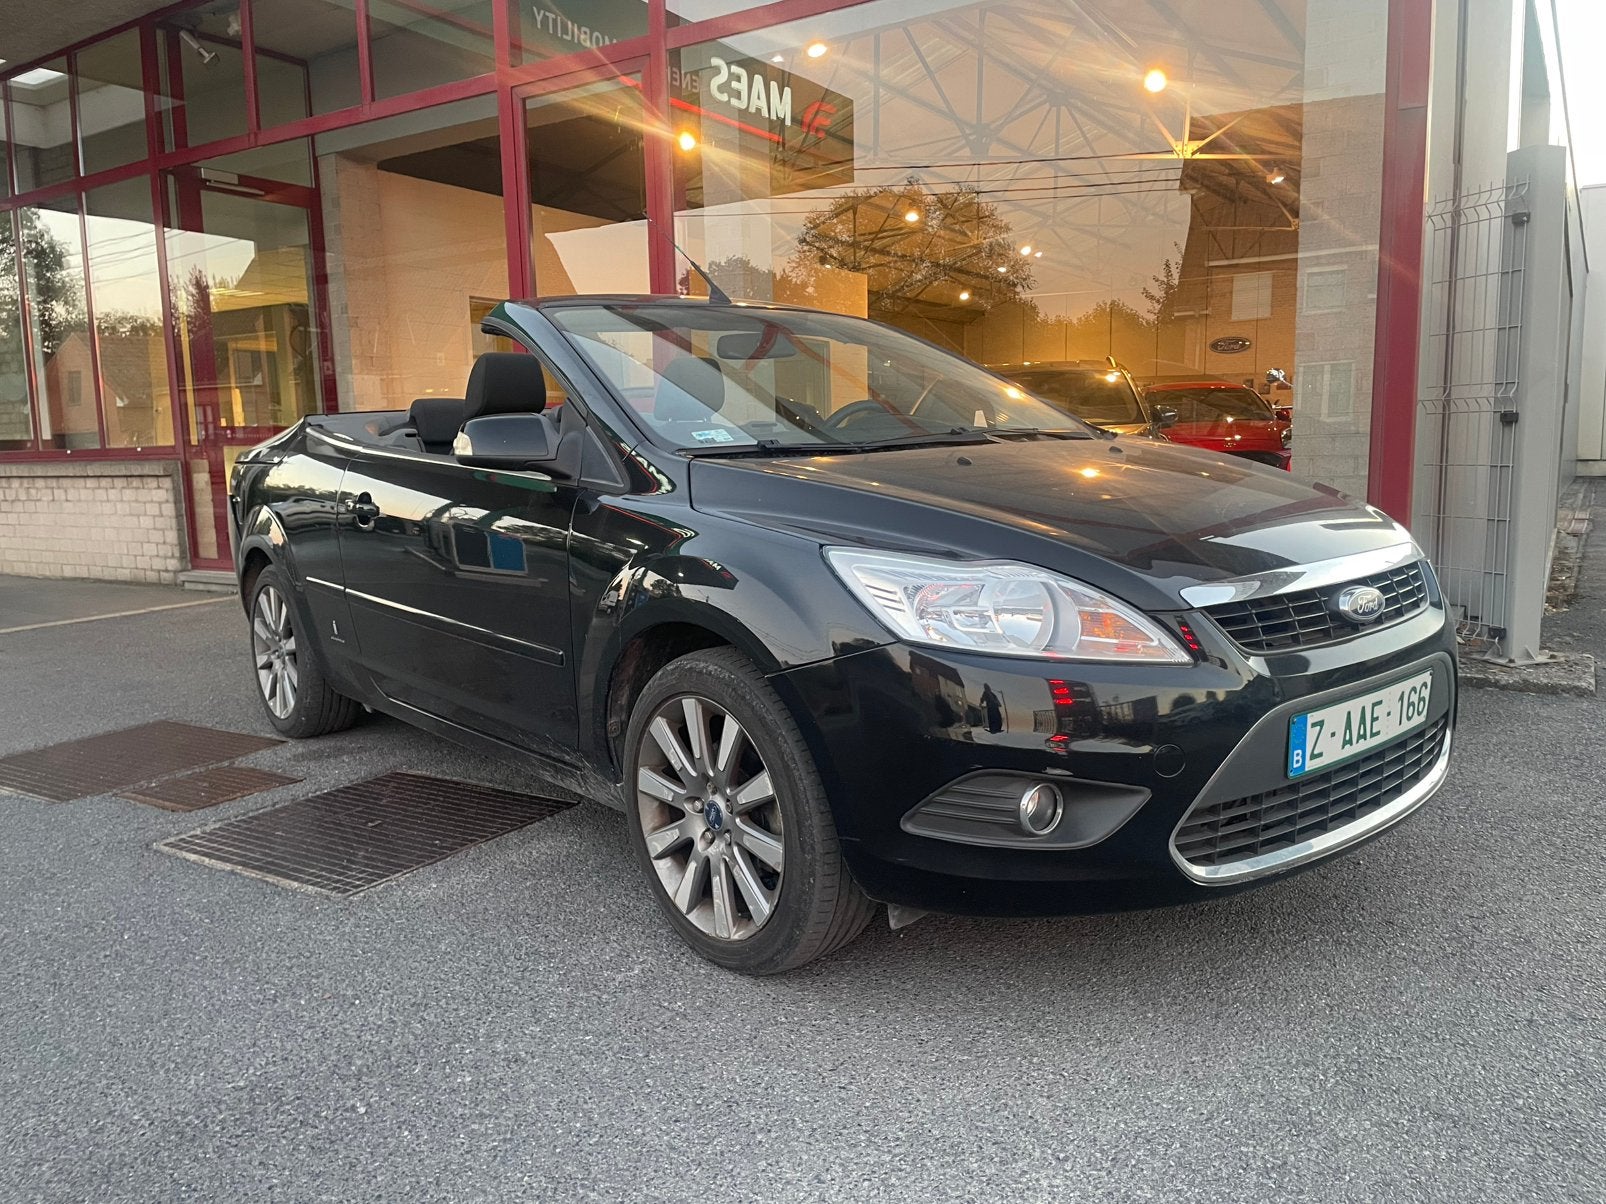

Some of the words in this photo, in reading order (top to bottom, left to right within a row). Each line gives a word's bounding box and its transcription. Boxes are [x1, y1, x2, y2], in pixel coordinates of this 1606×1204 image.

[1357, 594, 1379, 614] Ford
[1309, 681, 1428, 761] Z-AAE-166
[1293, 749, 1303, 769] B
